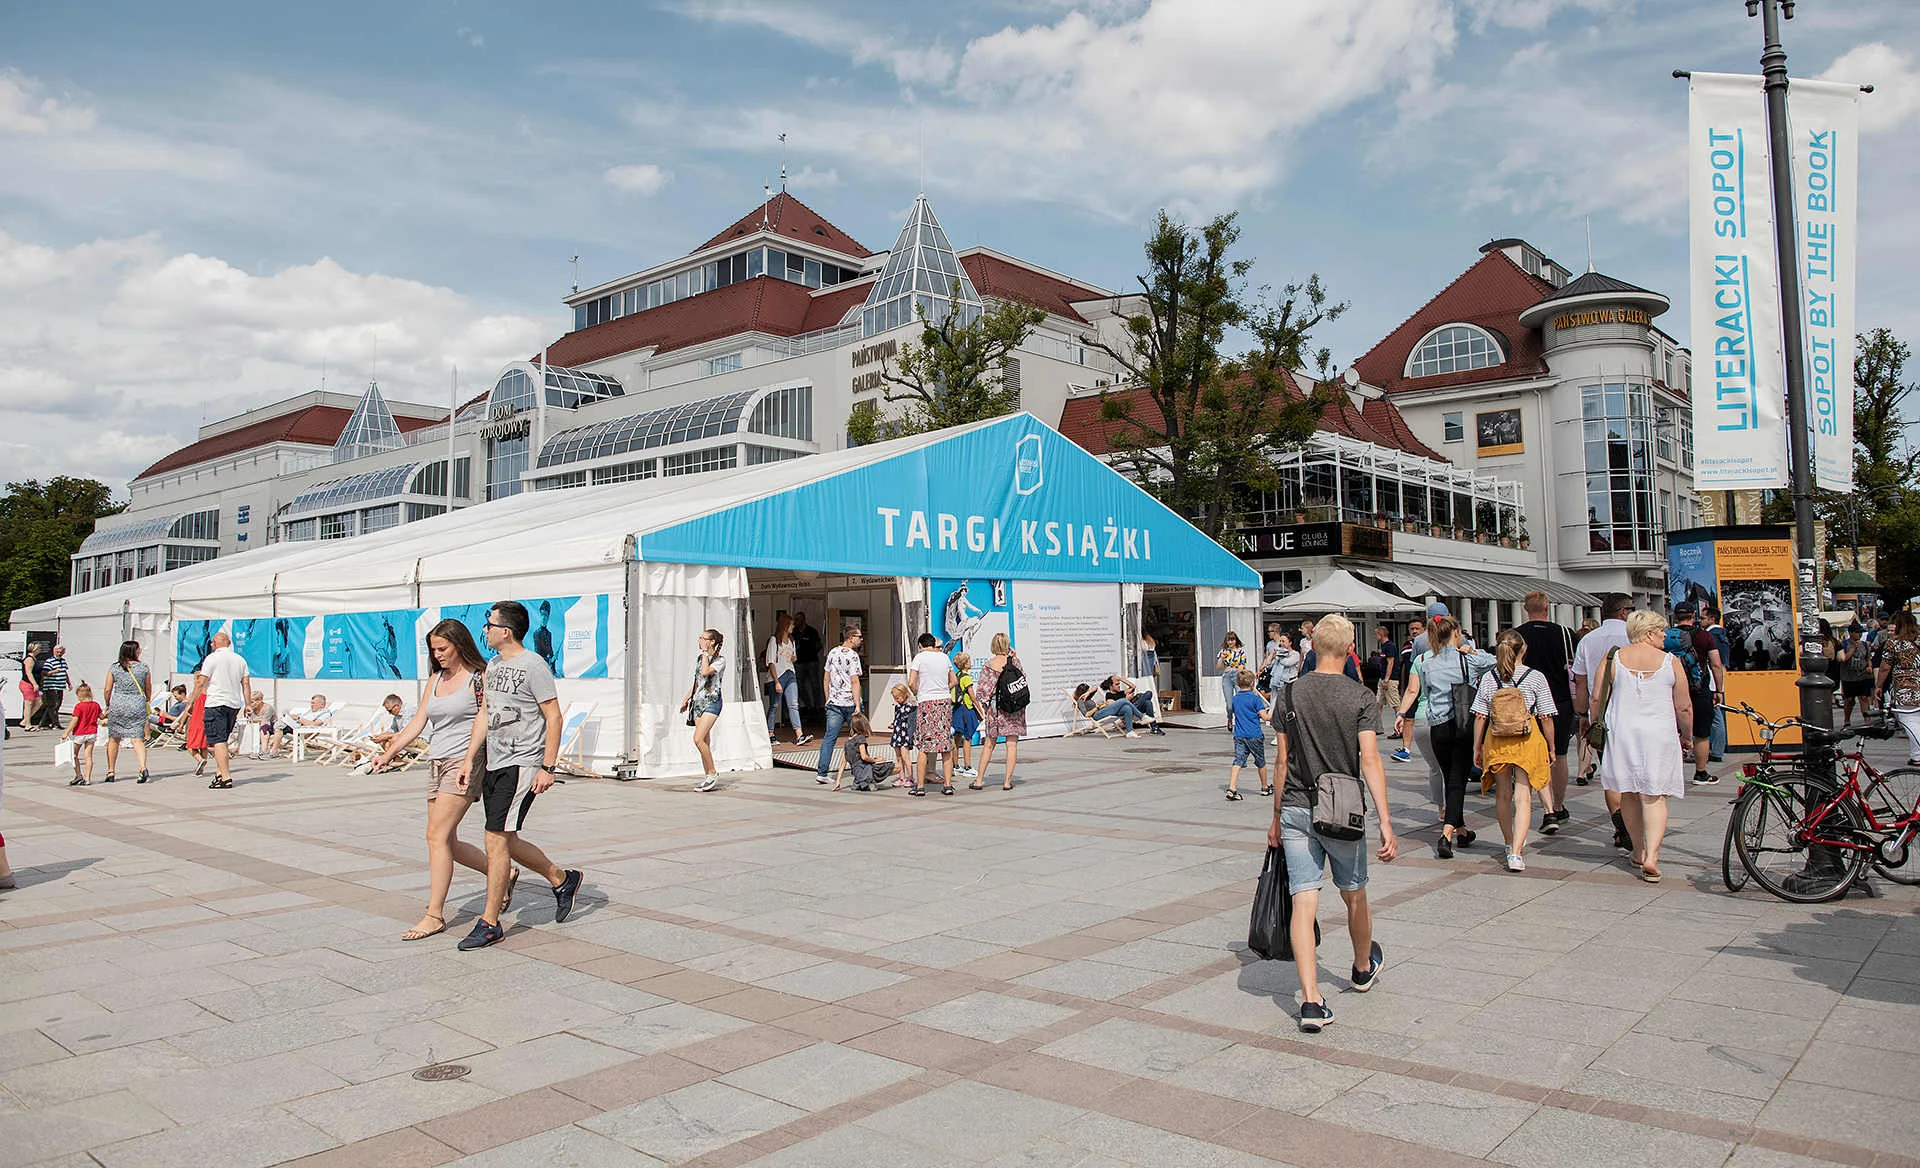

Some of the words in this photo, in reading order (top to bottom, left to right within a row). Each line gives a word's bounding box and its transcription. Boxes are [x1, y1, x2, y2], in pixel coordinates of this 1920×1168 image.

[1709, 128, 1737, 239] SOPOT
[1807, 129, 1829, 212] BOOK
[1807, 221, 1828, 279] THE
[1808, 289, 1828, 328] BY
[852, 339, 898, 368] PAŃSTWOWA
[1715, 255, 1748, 431] LITERACKI
[852, 370, 881, 393] GALERIA
[1812, 336, 1833, 436] SOPOT
[492, 404, 513, 419] DOM
[480, 420, 524, 440] ZDROJOWY
[877, 507, 1000, 553] TARGI
[1021, 516, 1151, 566] KSIĄŻKI
[1301, 532, 1322, 541] CLUB
[1301, 539, 1329, 548] LOUNGE
[1007, 675, 1027, 694] VANS
